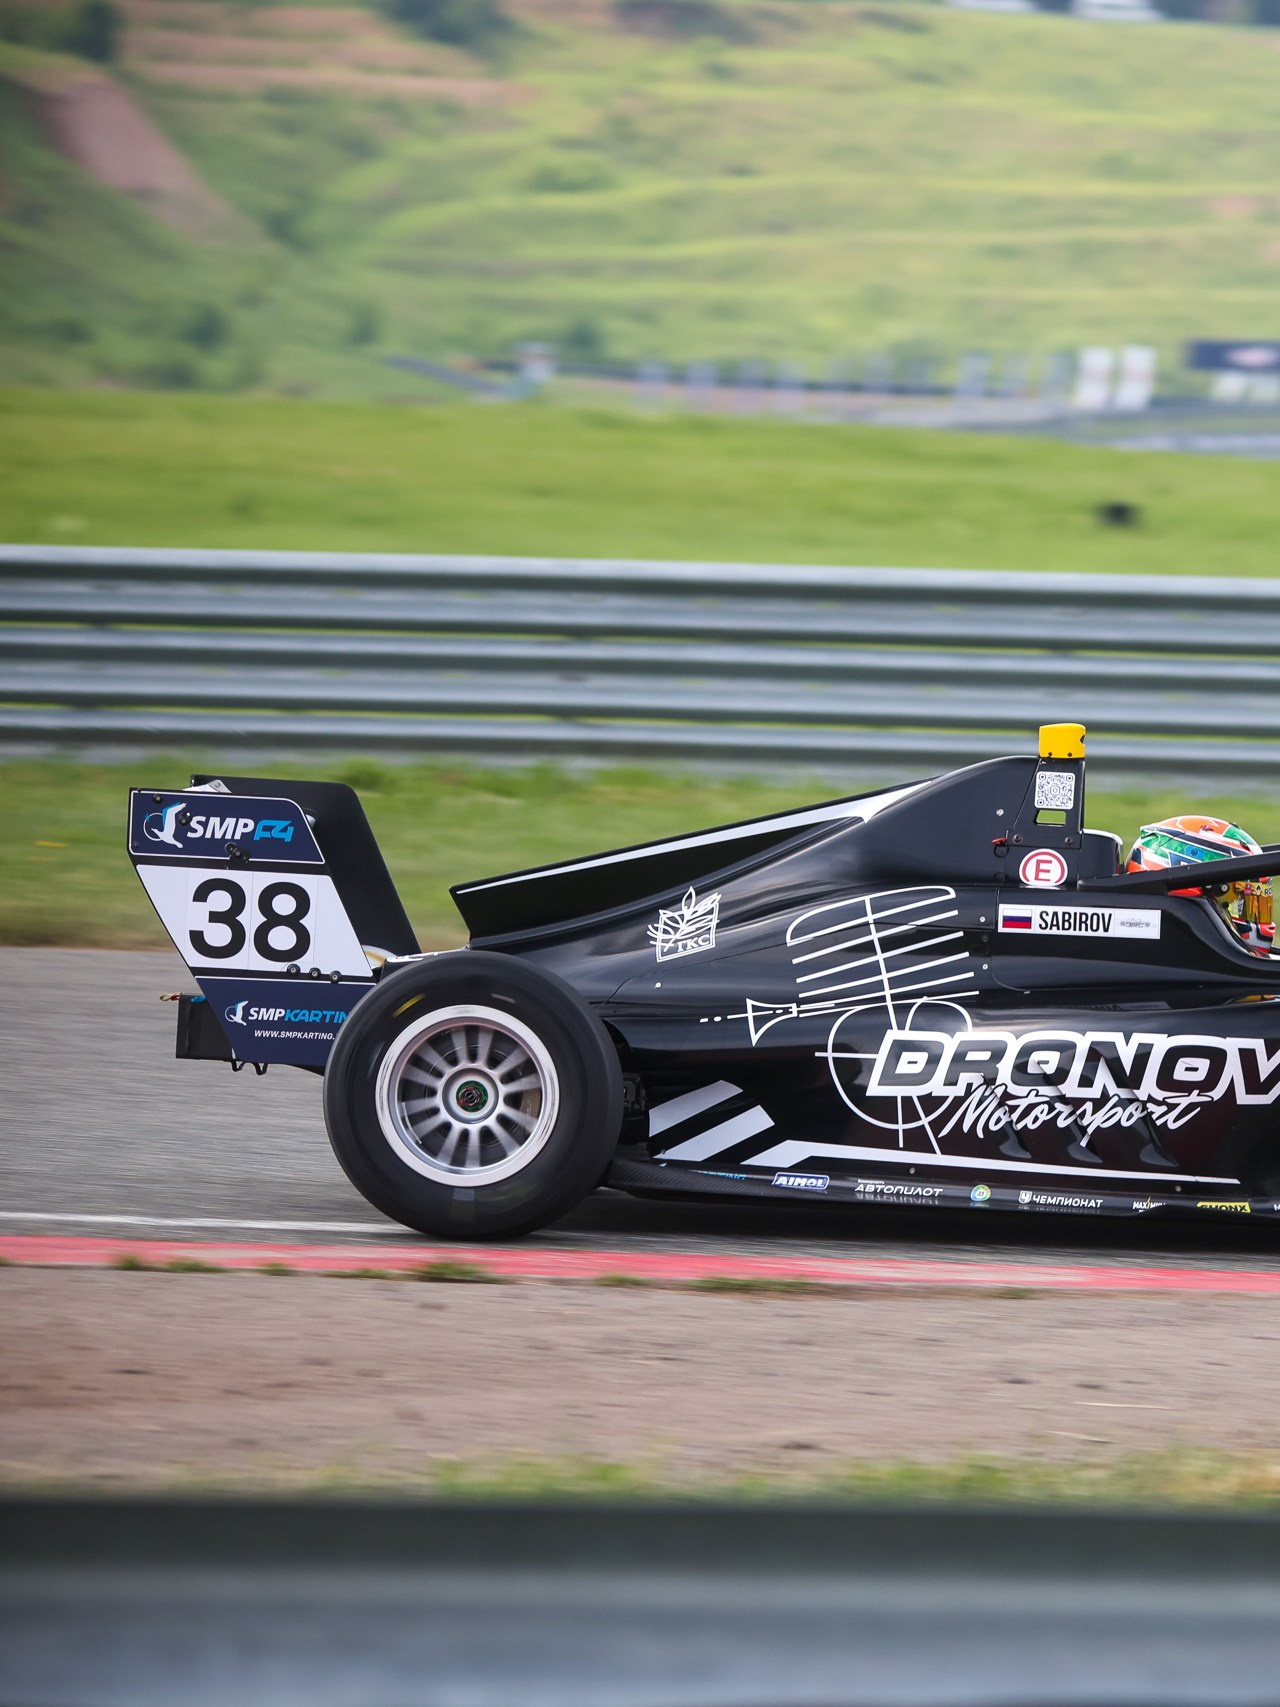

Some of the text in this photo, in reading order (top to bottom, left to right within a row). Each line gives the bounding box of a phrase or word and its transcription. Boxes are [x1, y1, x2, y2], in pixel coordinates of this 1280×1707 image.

[1034, 859, 1053, 881] E
[188, 878, 311, 963] 38
[1039, 910, 1113, 933] SABIROV
[677, 934, 710, 953] ГКС
[254, 1029, 337, 1040] WWW.SMPKARTING.
[937, 1084, 1215, 1148] Motorsport
[1033, 1194, 1104, 1209] ЧЕМПИОНАТ
